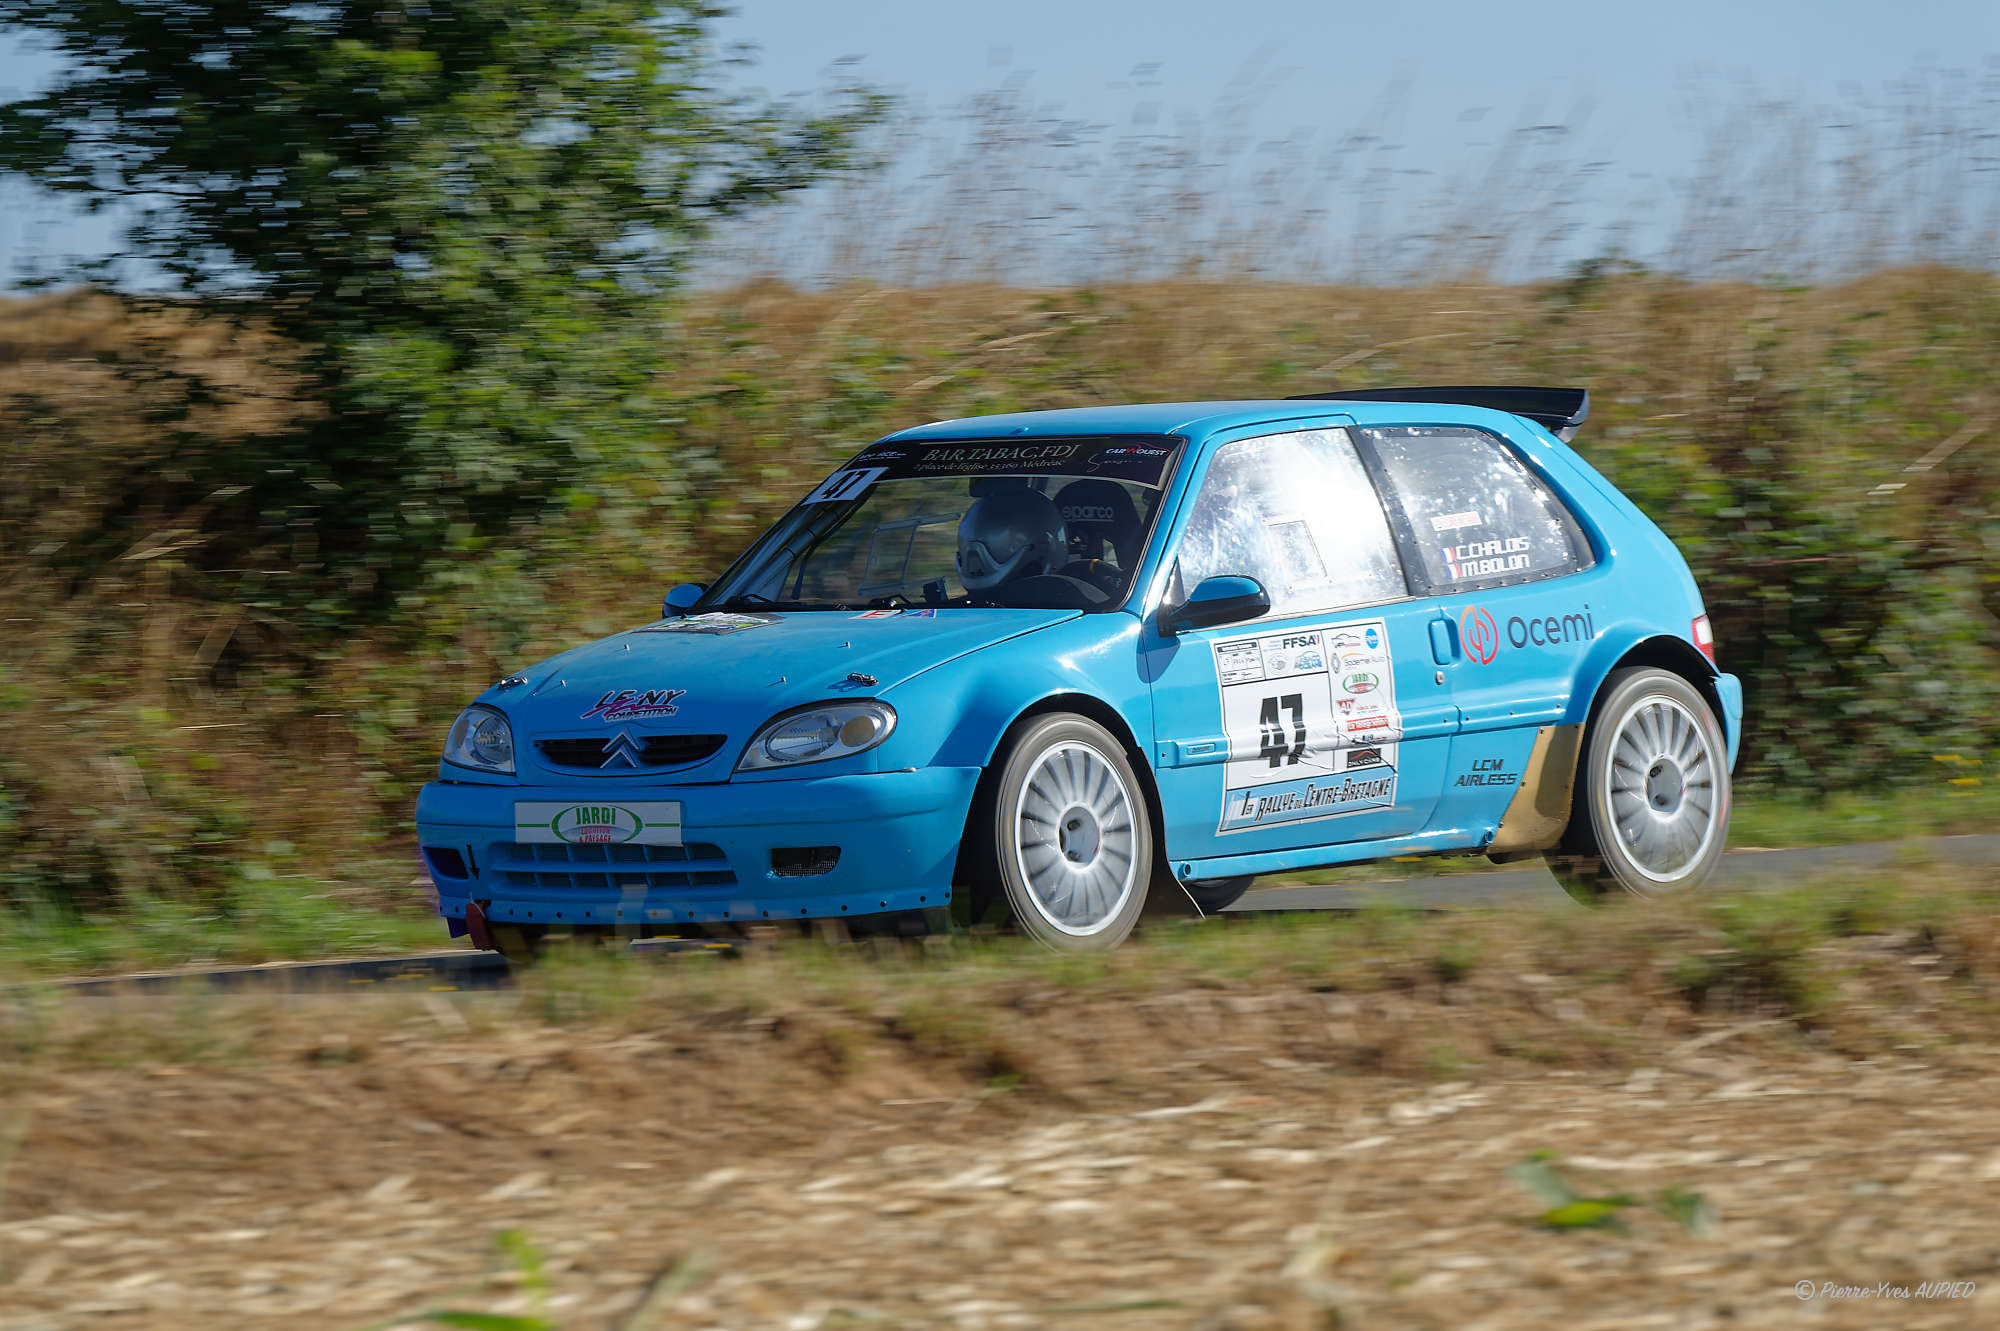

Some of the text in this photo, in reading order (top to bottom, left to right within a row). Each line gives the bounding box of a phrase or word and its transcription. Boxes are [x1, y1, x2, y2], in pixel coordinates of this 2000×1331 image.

[1063, 506, 1113, 519] sparco
[1282, 634, 1317, 650] FFSA
[605, 706, 679, 722] COMPETITION
[1259, 693, 1306, 768] 47
[1454, 773, 1518, 787] AIRLESS
[1255, 793, 1297, 821] RALLYE
[576, 807, 616, 825] JARDI
